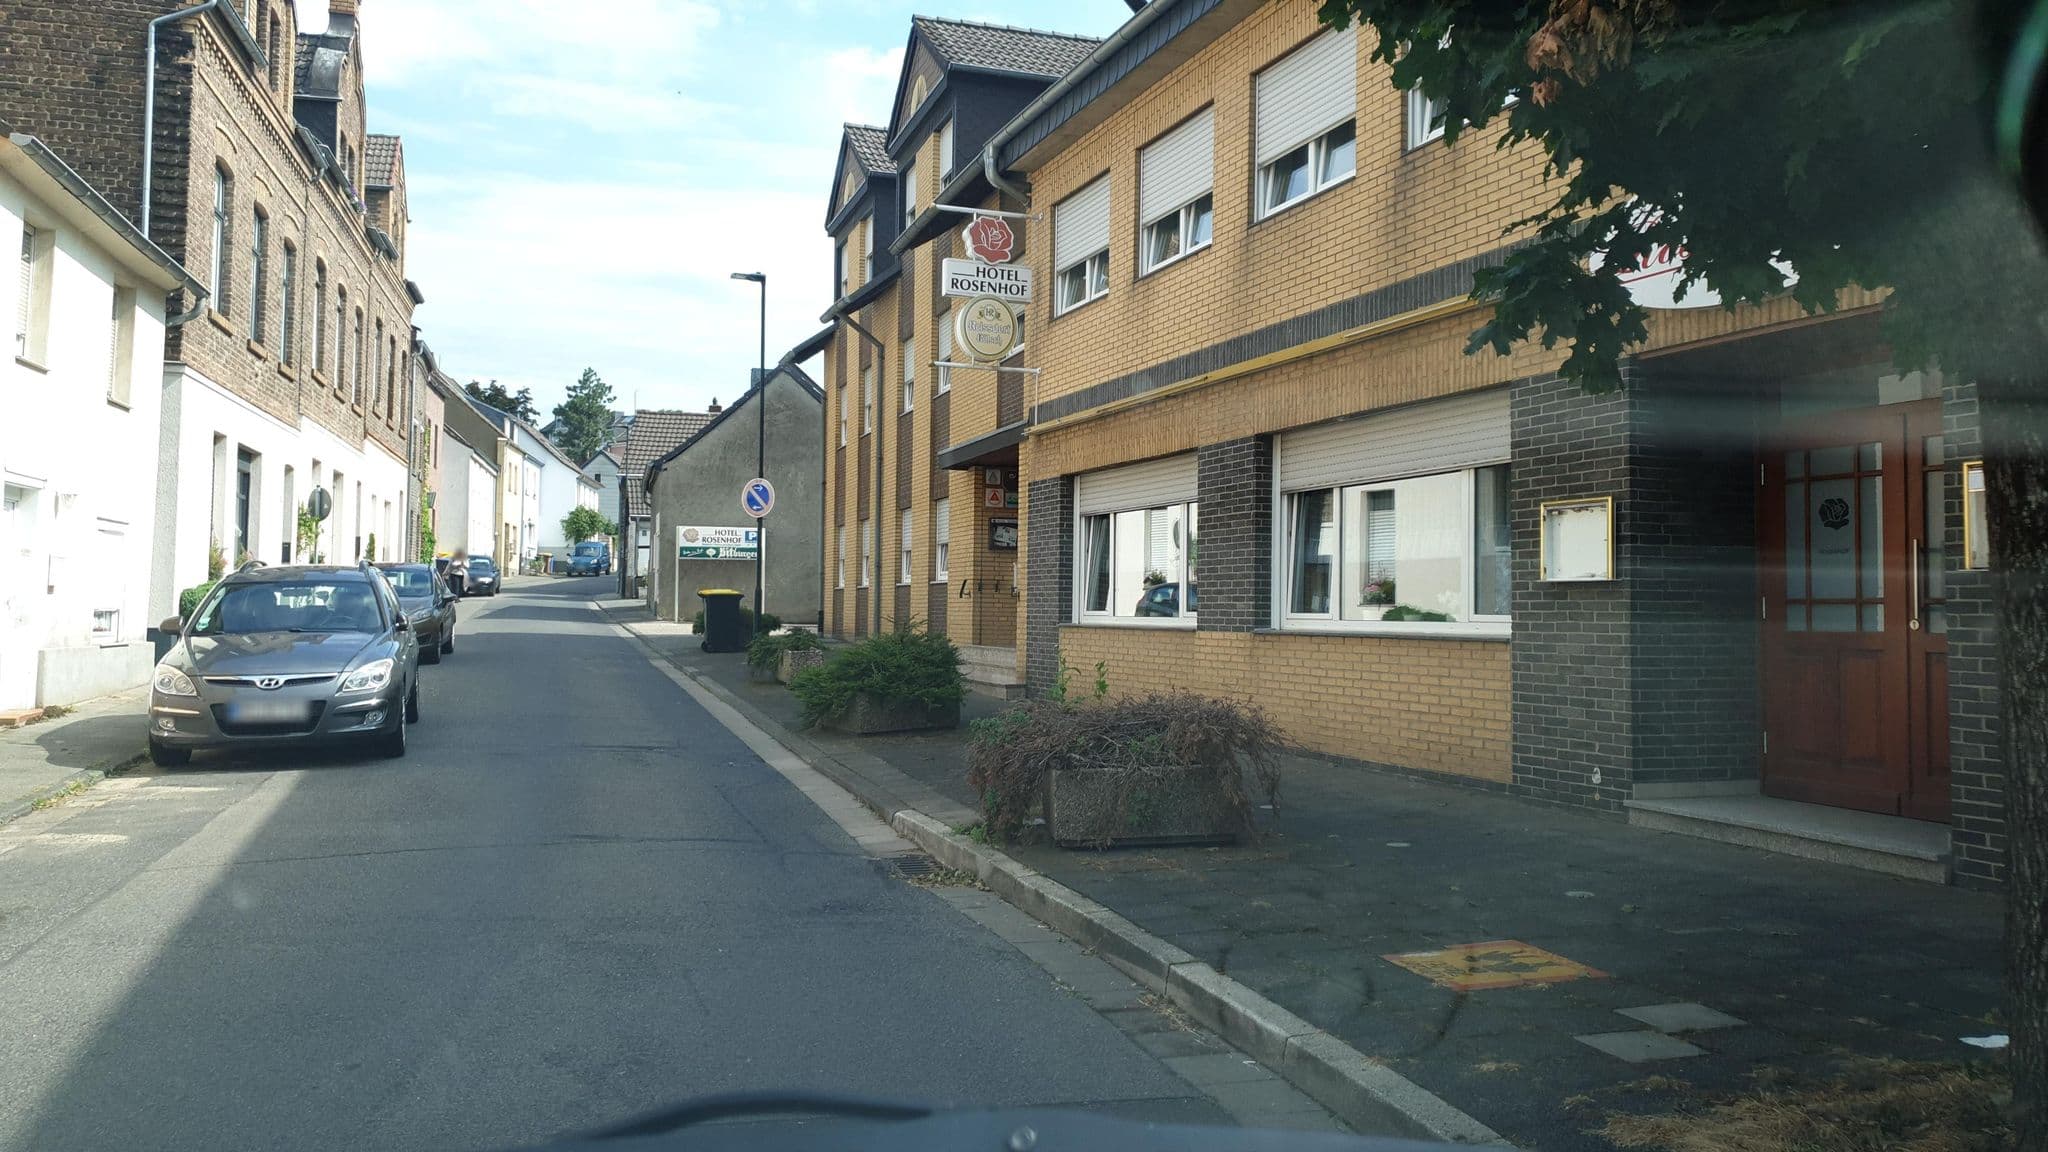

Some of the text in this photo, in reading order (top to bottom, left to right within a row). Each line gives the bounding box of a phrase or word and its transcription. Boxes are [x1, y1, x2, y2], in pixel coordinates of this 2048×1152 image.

[976, 266, 1020, 282] HOTEL
[951, 277, 1028, 296] ROSENHOF
[702, 536, 742, 544] ROSENHOF
